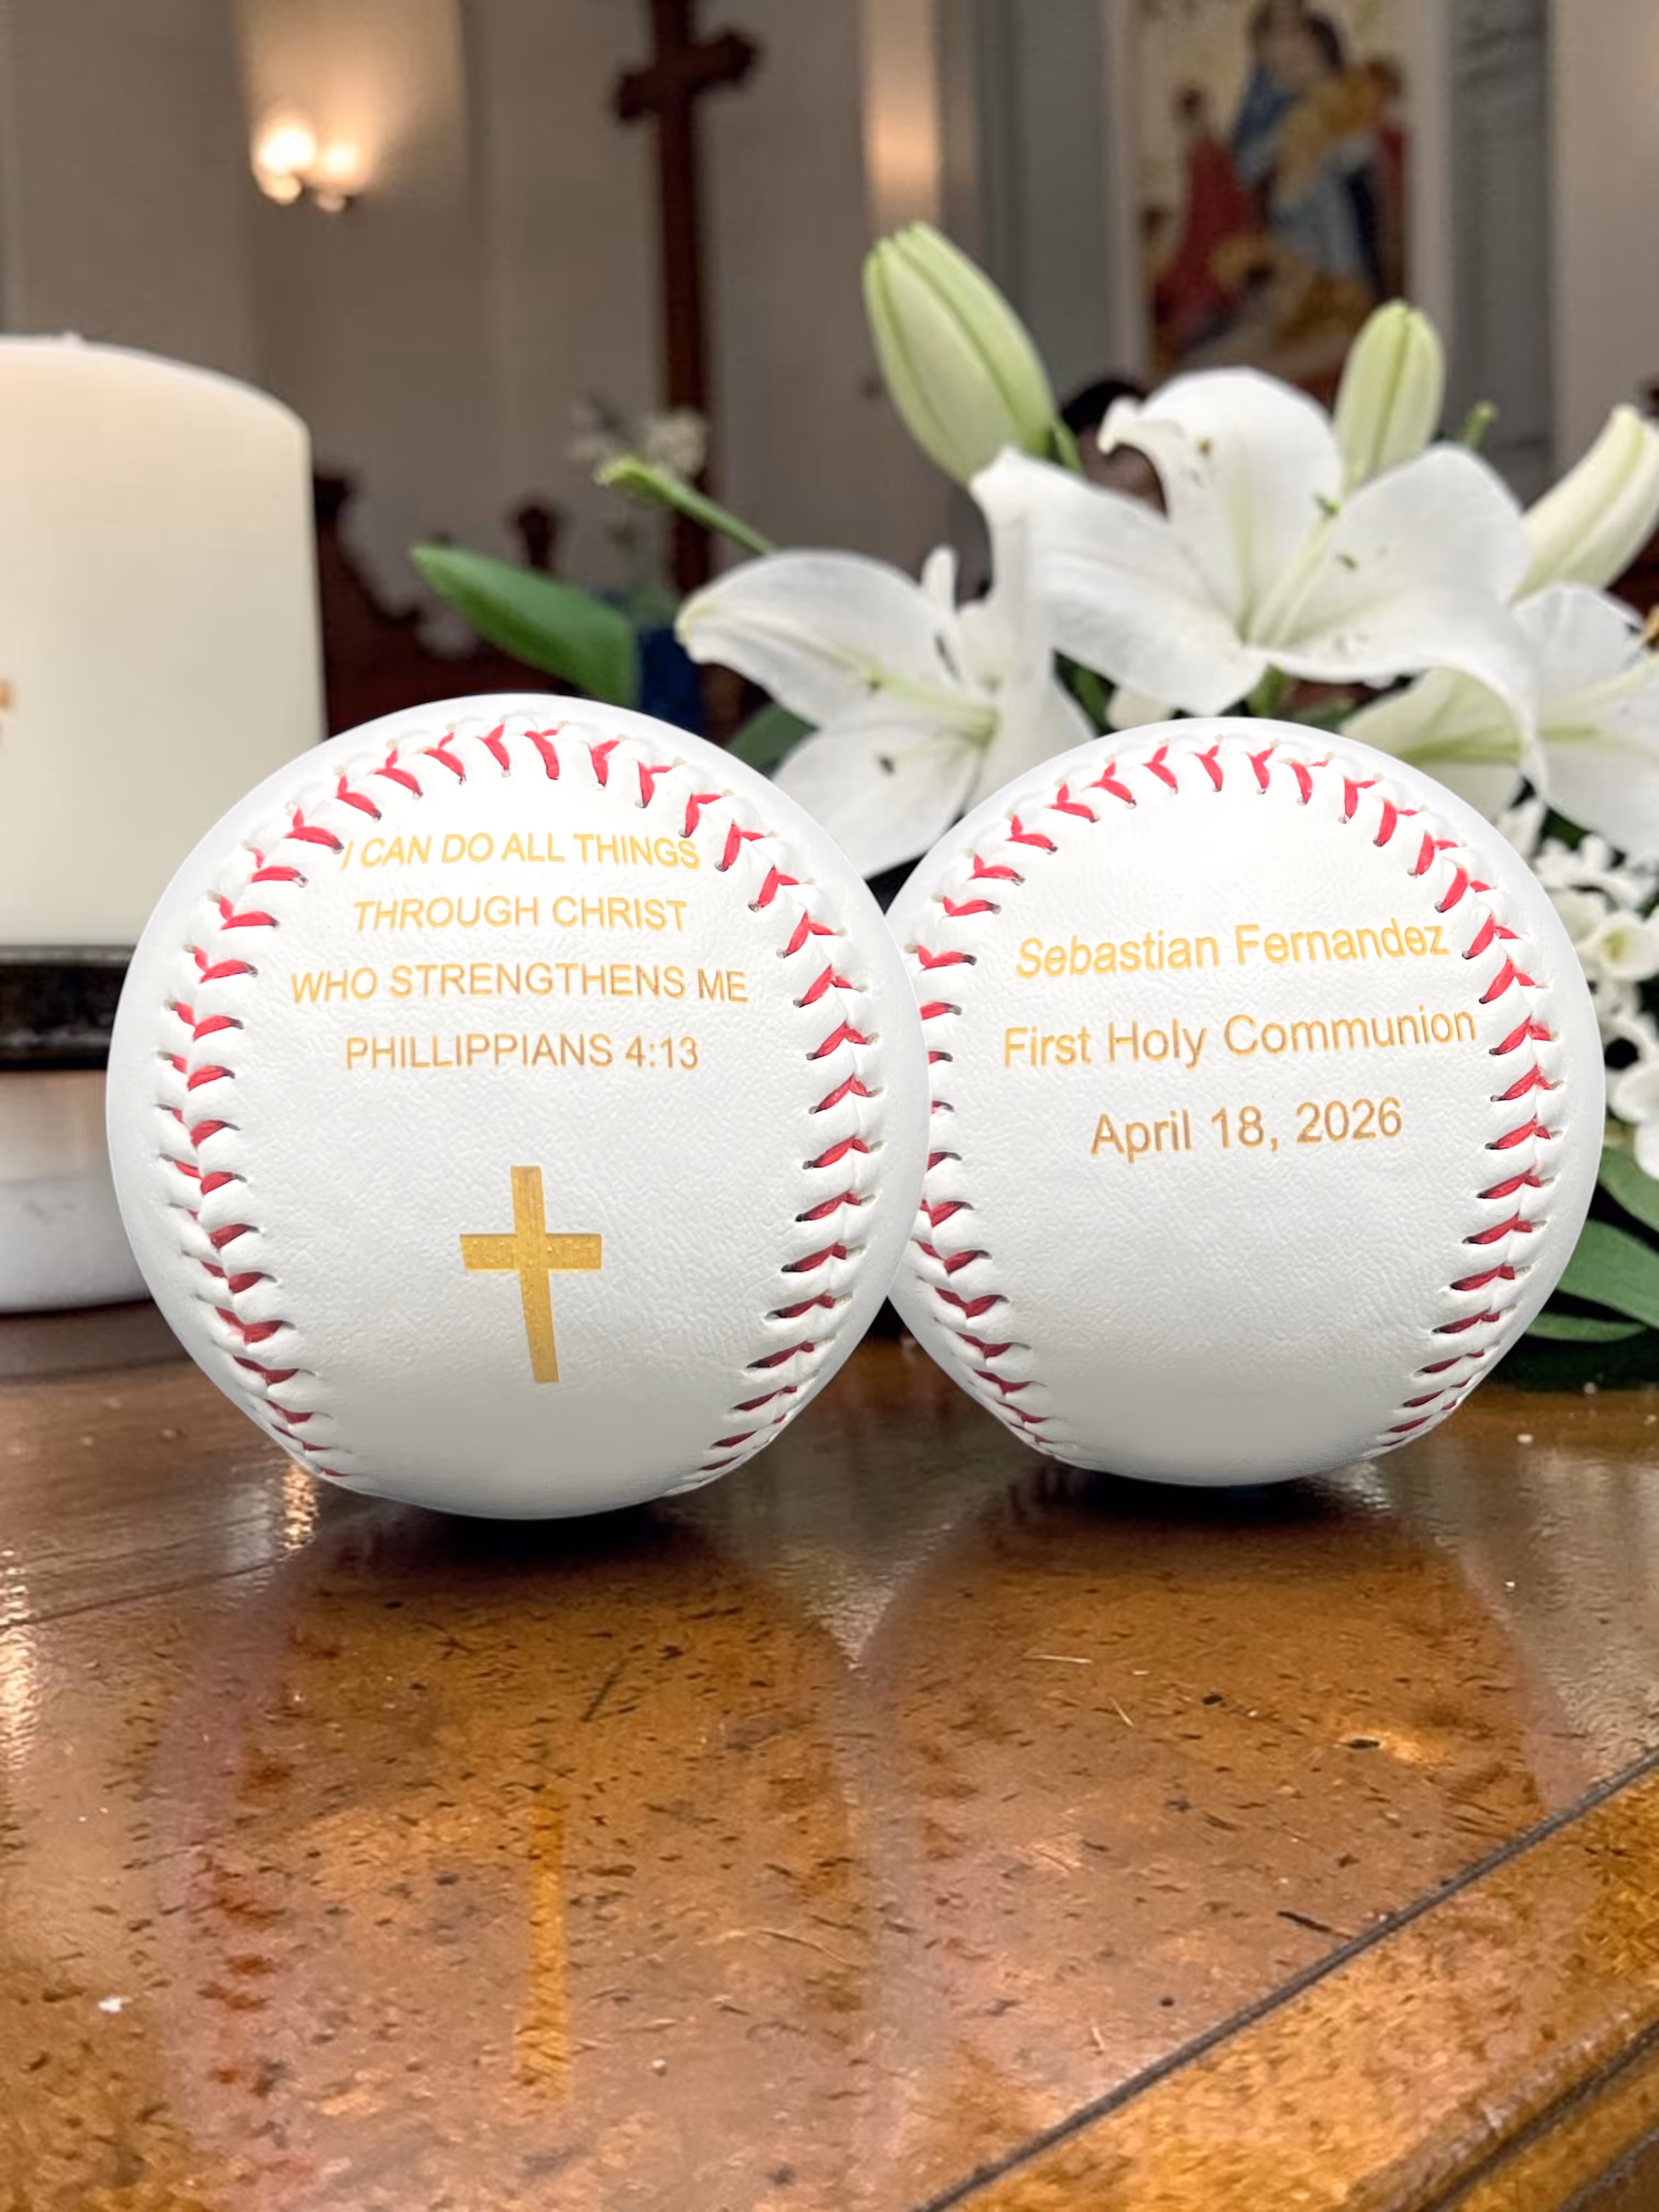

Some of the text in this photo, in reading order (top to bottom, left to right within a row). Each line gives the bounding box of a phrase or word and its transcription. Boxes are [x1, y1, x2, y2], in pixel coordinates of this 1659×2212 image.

[341, 832, 701, 870] I CAN DO ALL THINGS
[353, 895, 687, 931] THROUGH CHRIST
[1015, 917, 1450, 979] Sebastian Fernandez
[291, 962, 749, 1003] WHO STRENGTHENS ME
[346, 1033, 698, 1070] PHILLIPPIANS 4:13
[1004, 1004, 1477, 1070] First Holy Communion
[1090, 1096, 1402, 1164] April 18, 2026
